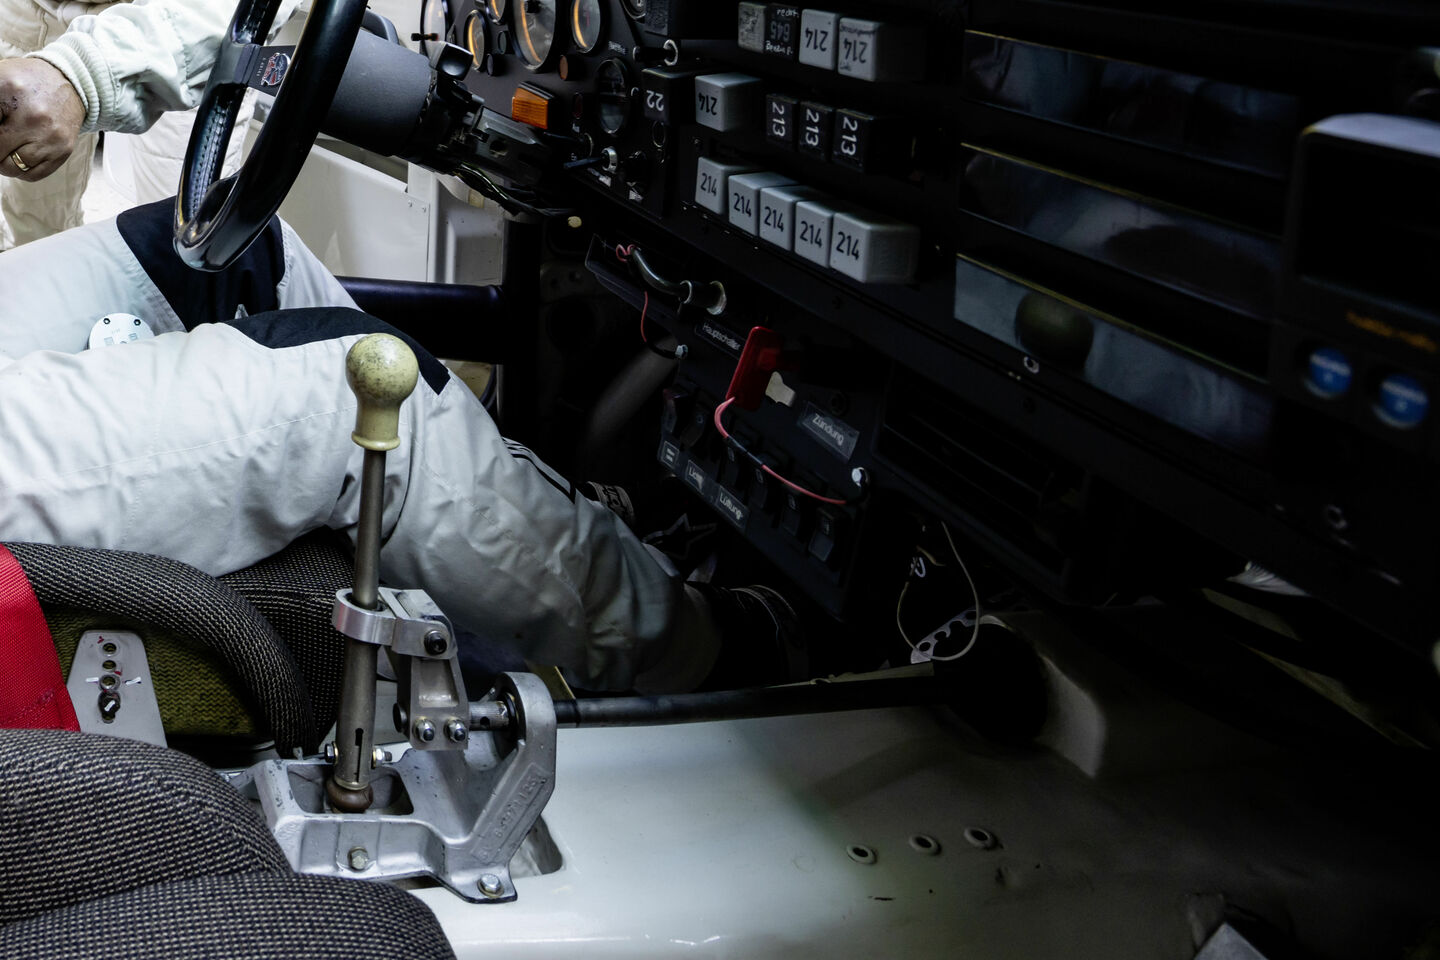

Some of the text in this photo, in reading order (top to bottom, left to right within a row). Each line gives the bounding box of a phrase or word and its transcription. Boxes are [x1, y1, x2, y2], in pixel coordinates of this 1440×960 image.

[805, 28, 829, 52] 214
[843, 38, 868, 63] 214
[698, 92, 719, 116] 214
[772, 100, 787, 138] 213
[805, 107, 820, 147] 213
[840, 115, 858, 157] 213
[700, 171, 718, 198] 214
[733, 190, 753, 218] 214
[764, 205, 785, 233] 214
[800, 219, 823, 249] 214
[836, 231, 861, 261] 214
